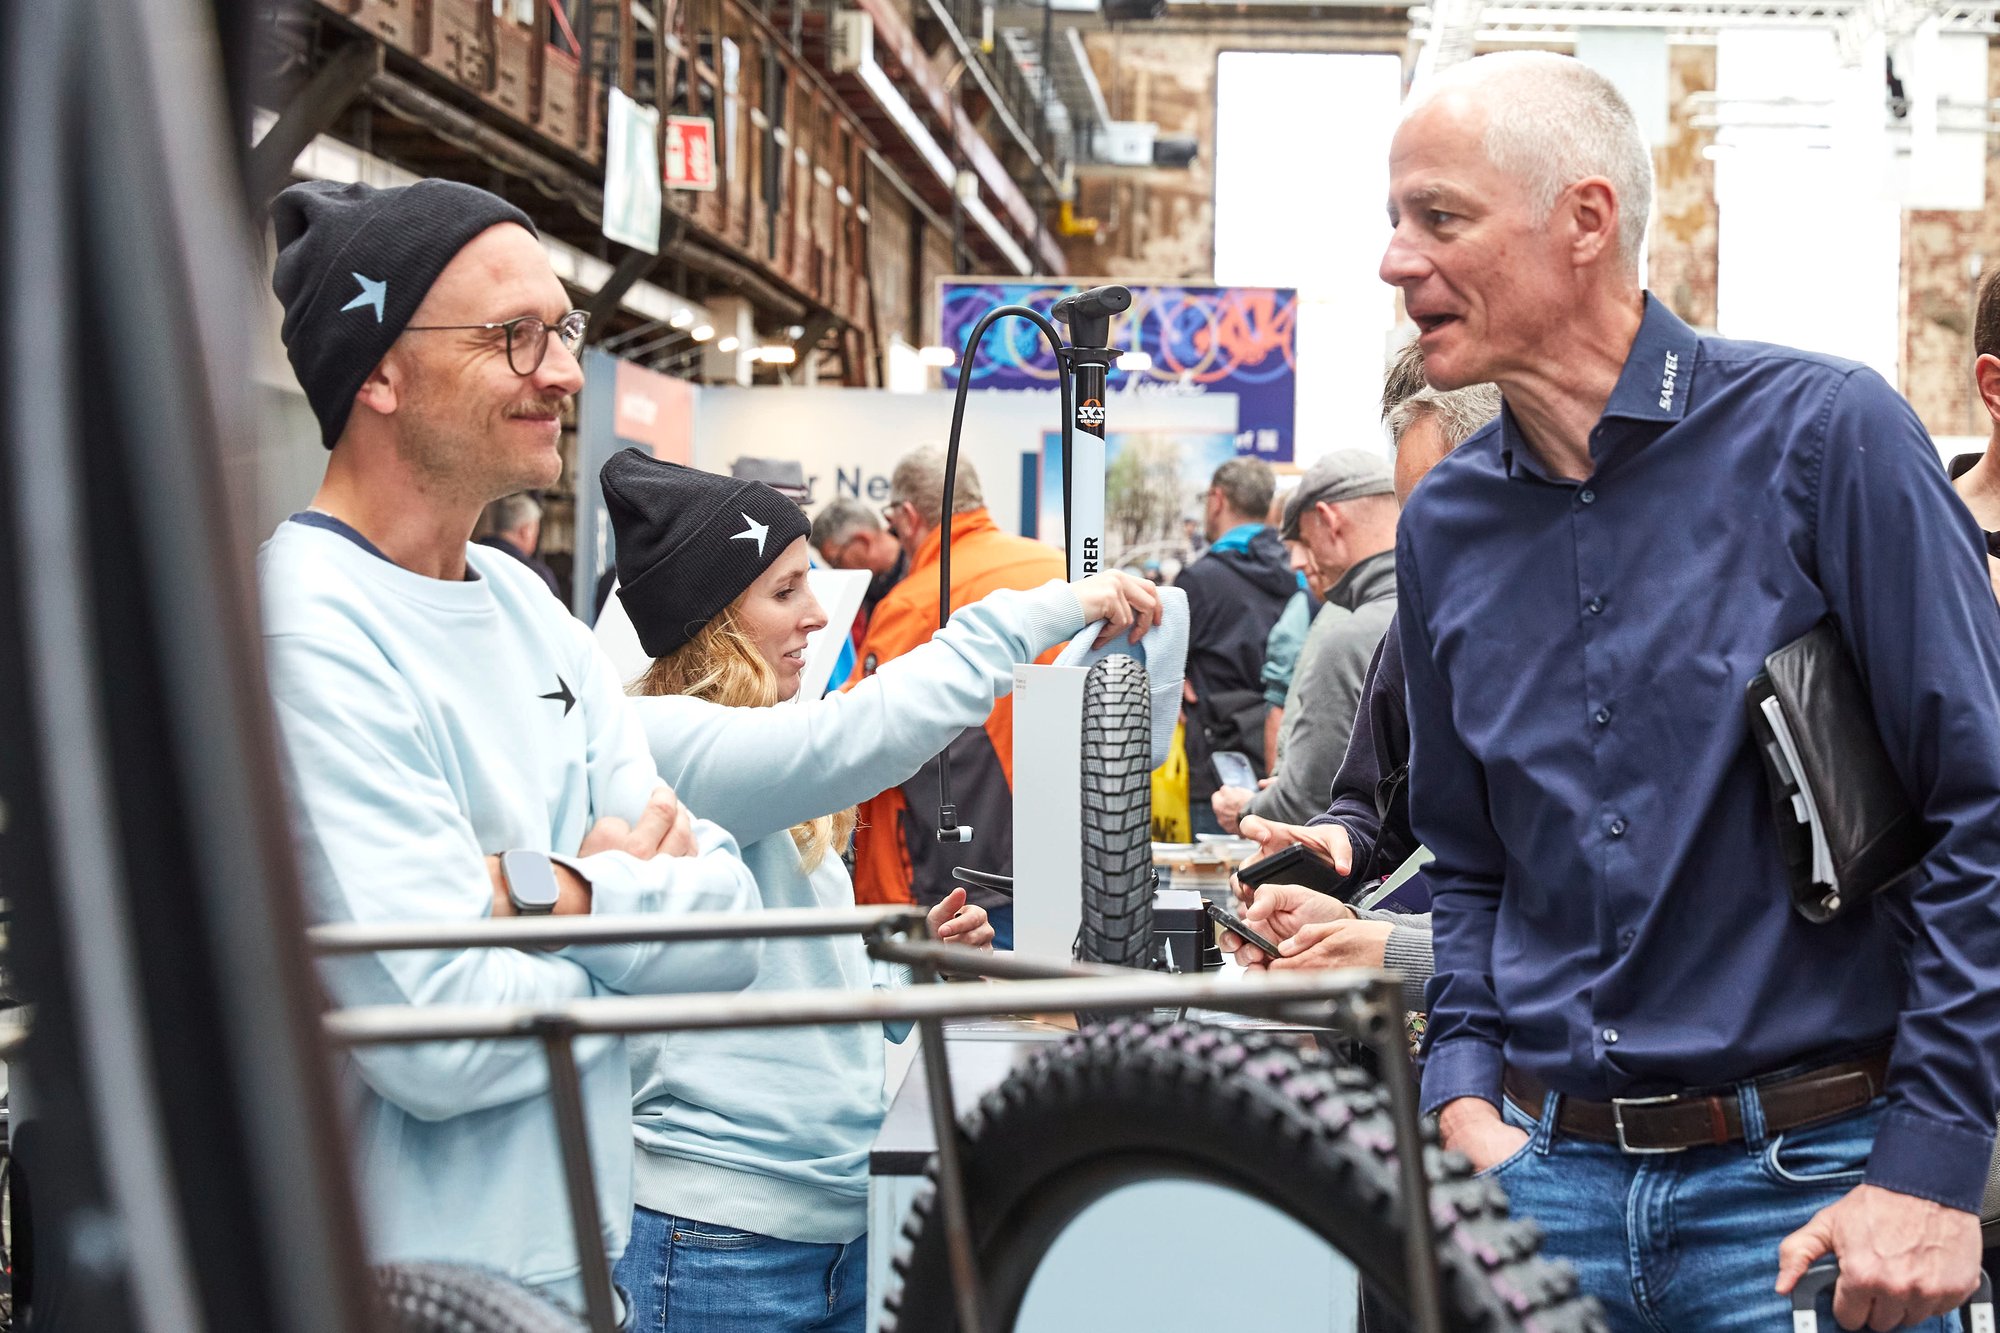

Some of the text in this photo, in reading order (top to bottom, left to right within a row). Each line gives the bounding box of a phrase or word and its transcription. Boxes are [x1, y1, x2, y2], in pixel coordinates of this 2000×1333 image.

[1659, 350, 1678, 412] SAS-TEC
[1077, 406, 1105, 419] SKS
[1083, 537, 1098, 578] RER
